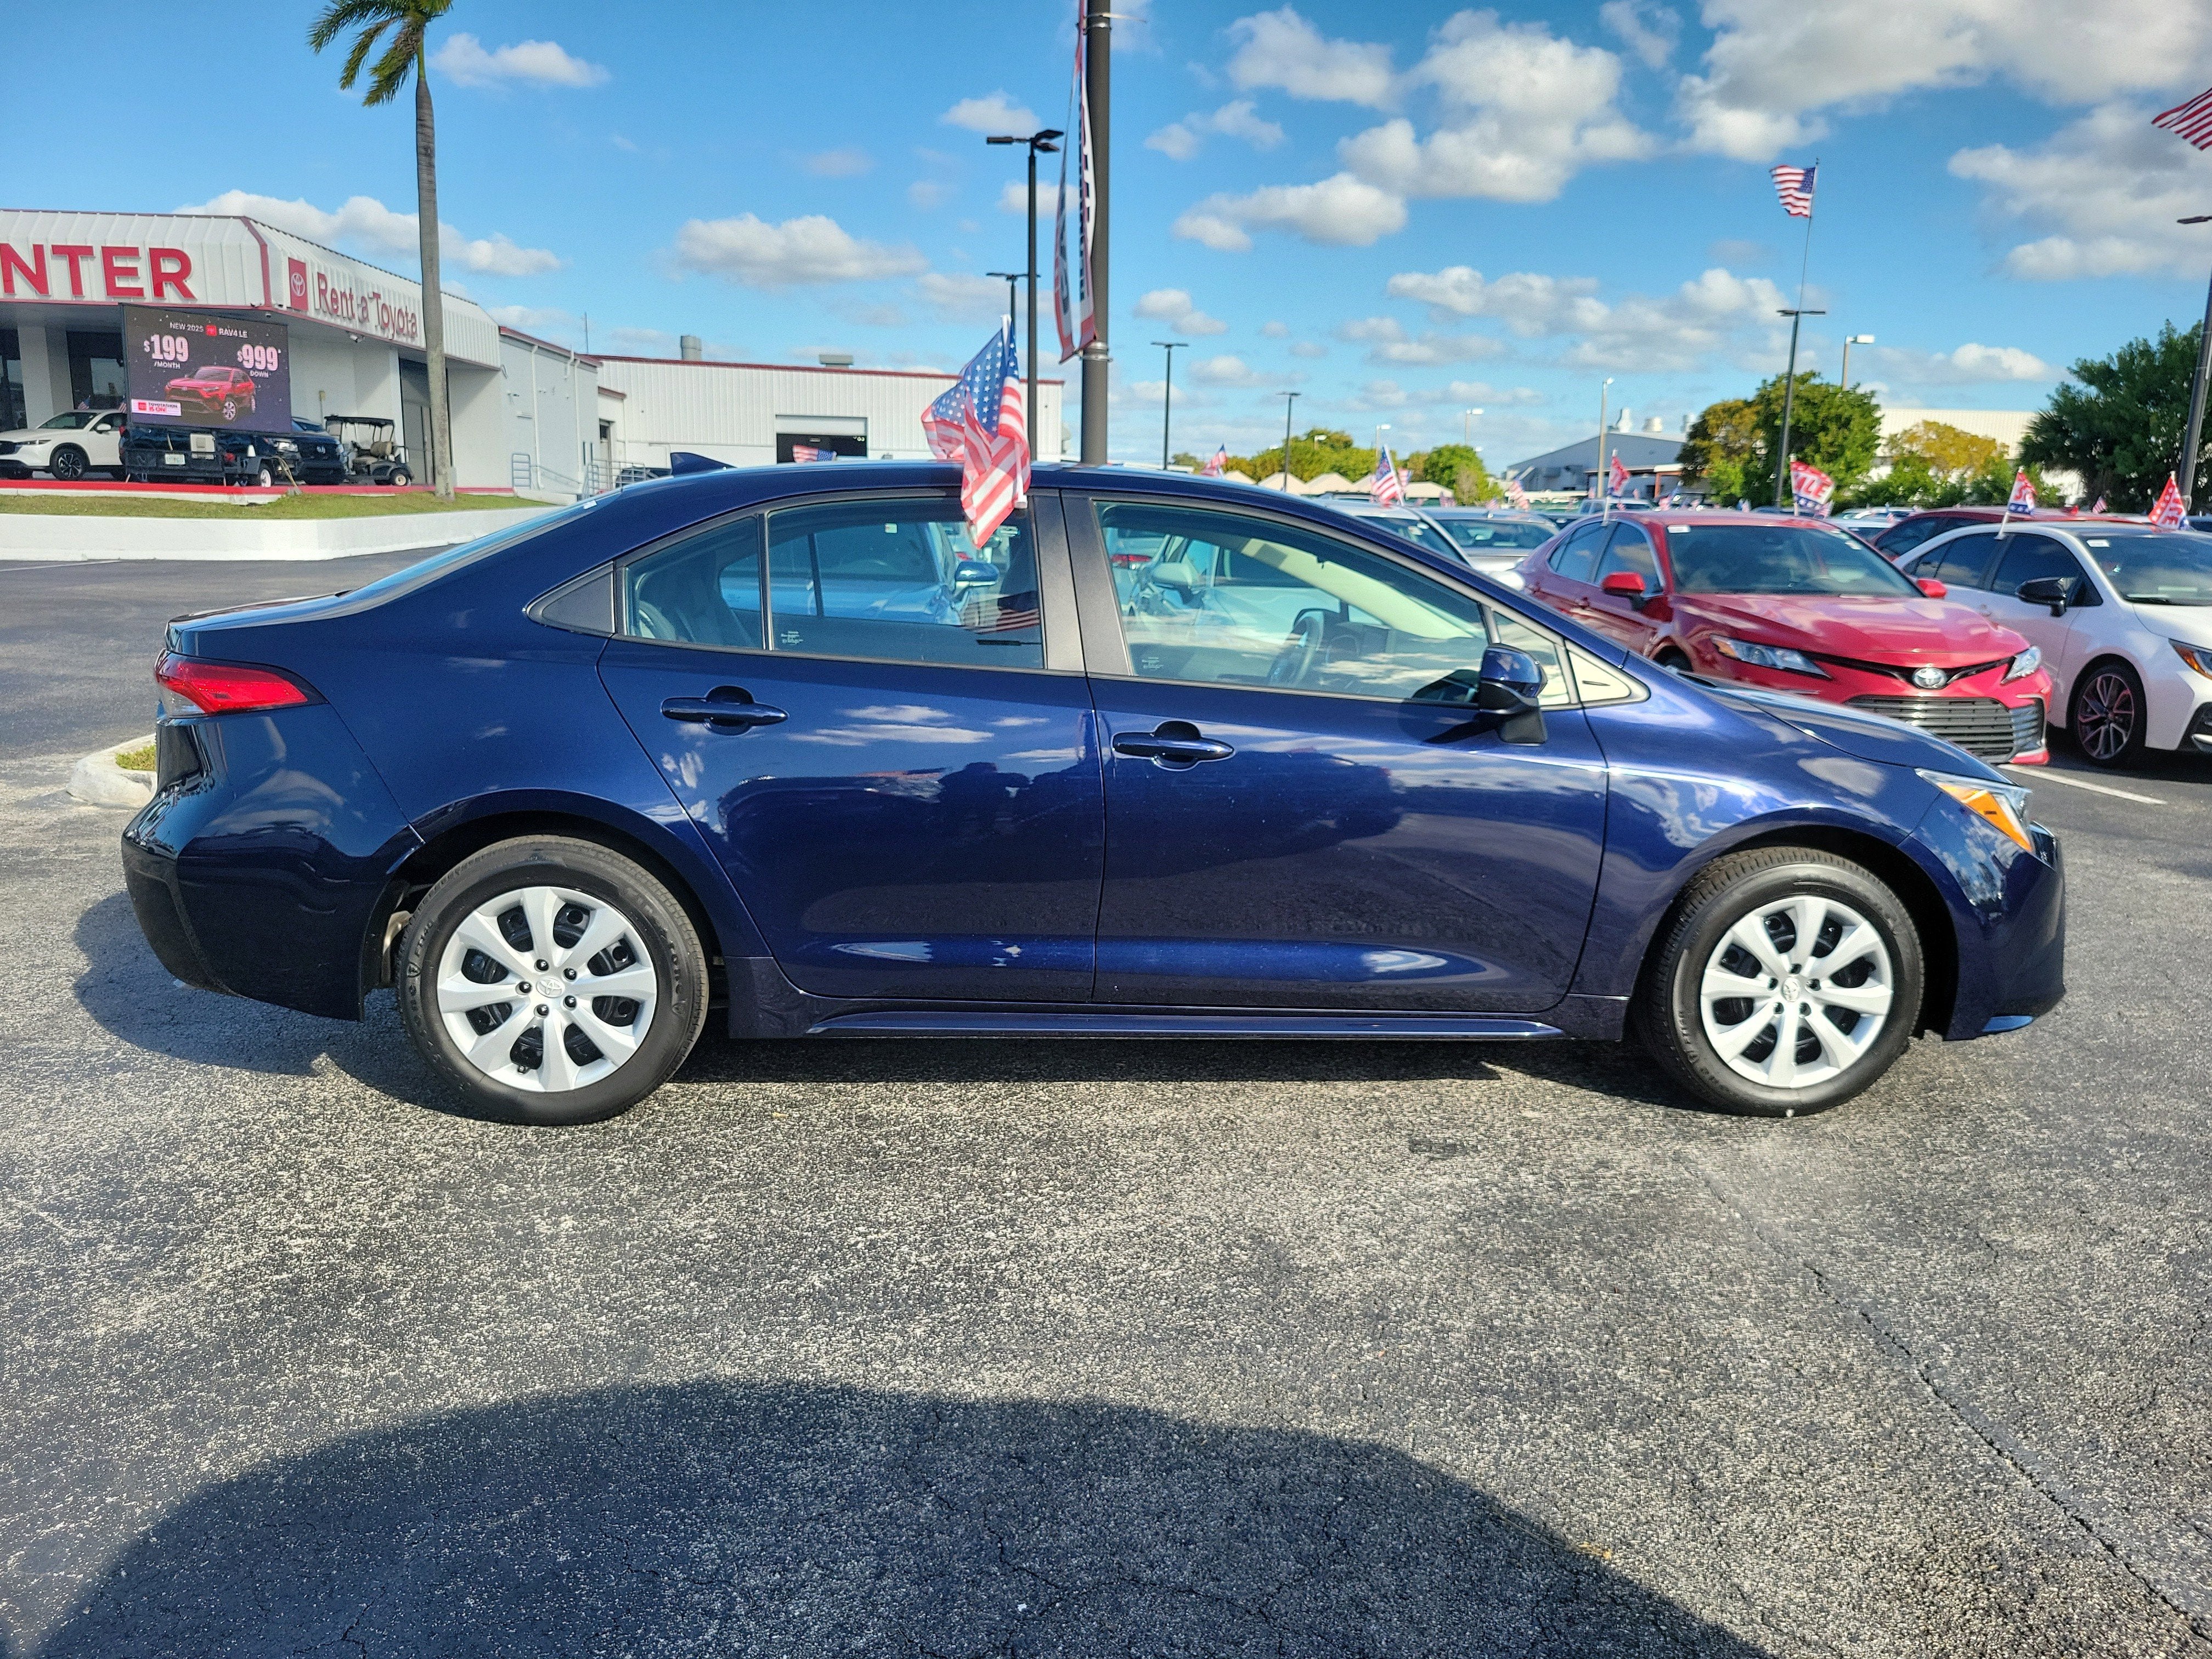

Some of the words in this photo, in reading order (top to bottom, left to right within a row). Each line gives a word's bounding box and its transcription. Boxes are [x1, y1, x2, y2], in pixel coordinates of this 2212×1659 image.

[0, 242, 199, 300] NTER
[313, 272, 356, 320] Rent
[358, 296, 370, 322] a
[369, 291, 419, 340] Toyota
[143, 334, 189, 362] $199
[170, 321, 186, 330] NEW
[186, 323, 204, 332] 2025
[218, 327, 238, 337] RAV4
